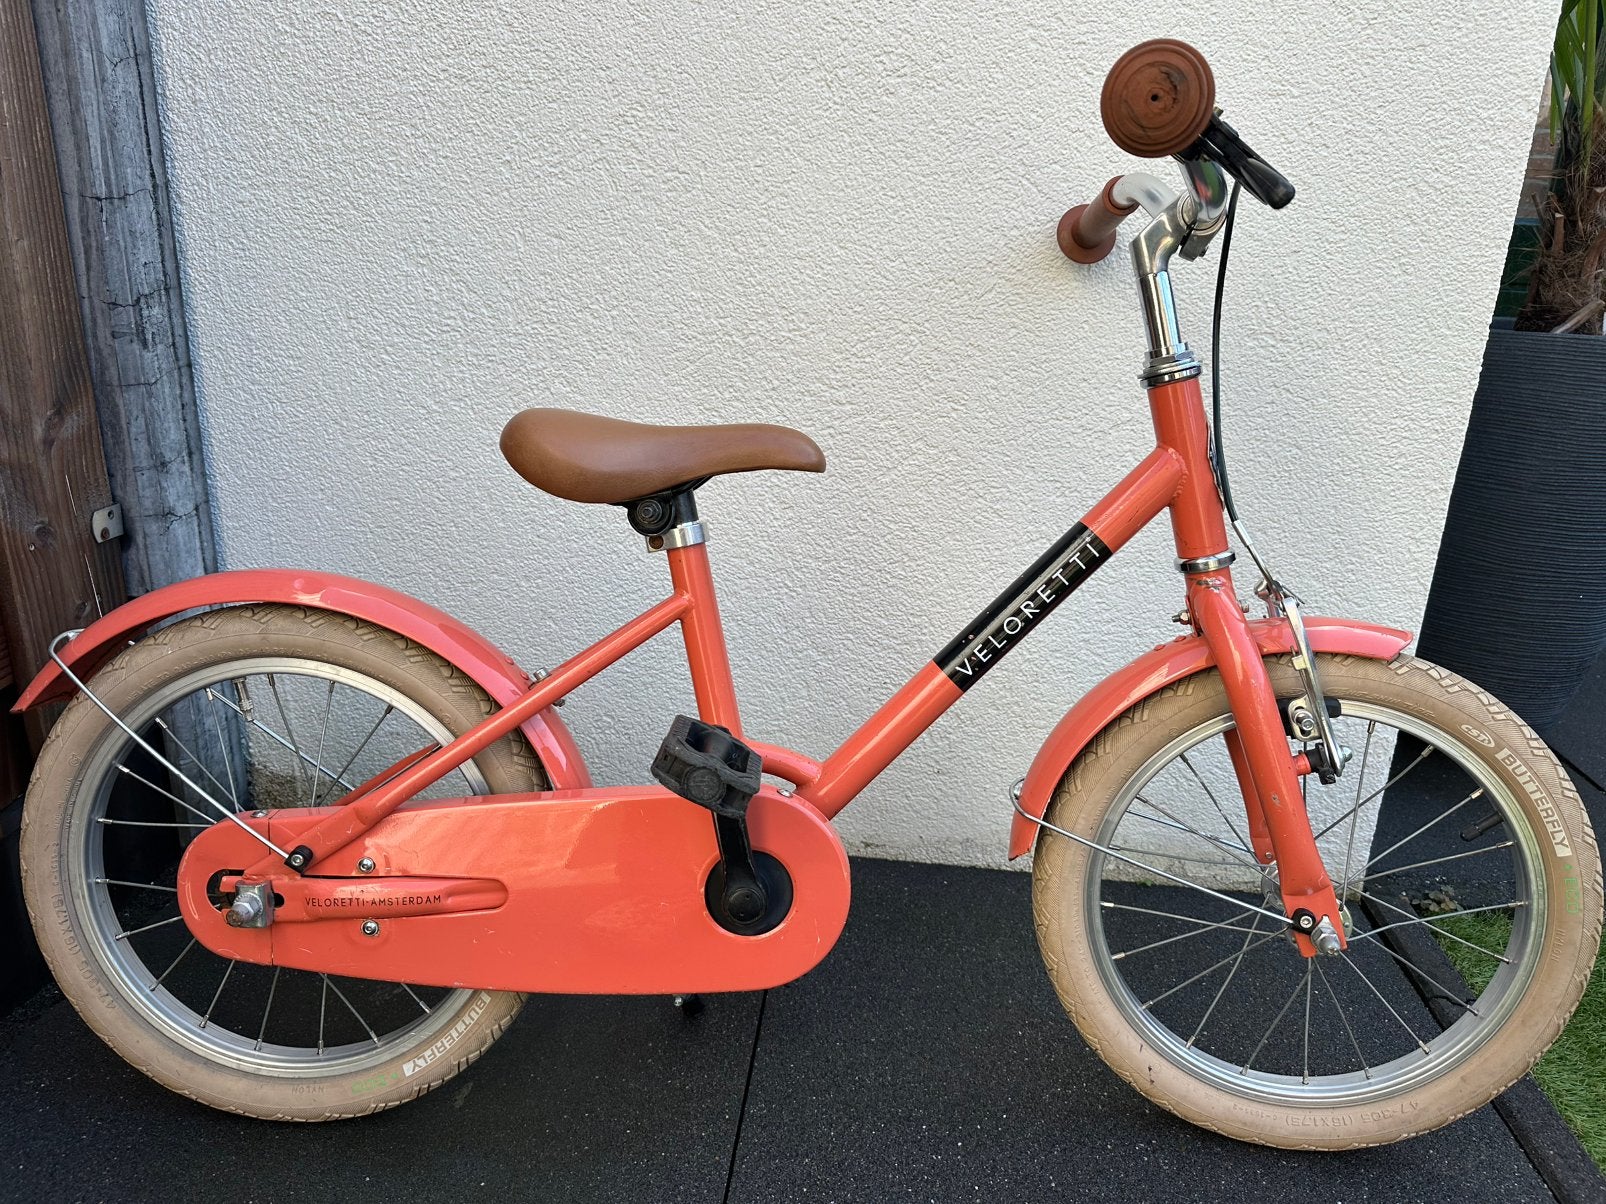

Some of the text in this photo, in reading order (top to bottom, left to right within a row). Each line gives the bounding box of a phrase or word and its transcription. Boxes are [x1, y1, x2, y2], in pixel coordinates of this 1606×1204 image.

[955, 543, 1100, 676] VELORETTI
[1500, 753, 1569, 850] BUTTERFLY
[411, 998, 489, 1074] BUTTERFLY
[1360, 1099, 1420, 1123] 47-305
